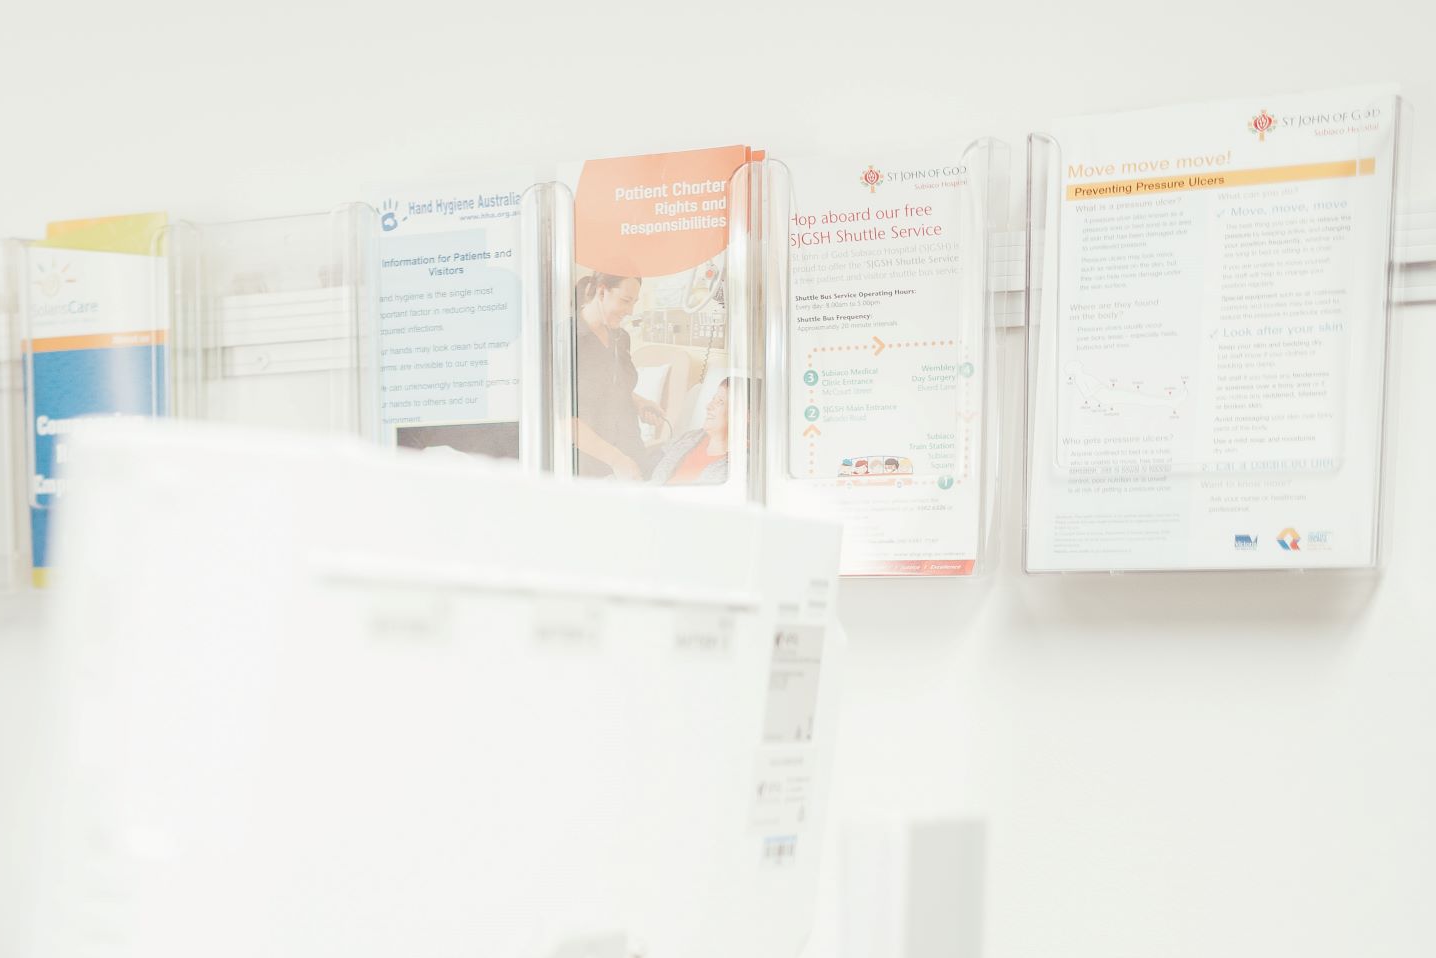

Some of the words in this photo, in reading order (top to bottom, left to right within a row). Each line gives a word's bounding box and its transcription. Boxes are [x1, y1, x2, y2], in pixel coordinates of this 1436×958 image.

[1282, 116, 1294, 127] ST
[1297, 114, 1330, 128] JOHN
[1332, 111, 1349, 122] OF
[1067, 163, 1116, 179] Move
[1121, 160, 1170, 174] move
[1176, 150, 1233, 169] move!
[886, 172, 898, 182] ST
[899, 169, 927, 182] JOHN
[927, 168, 942, 178] OF
[942, 165, 968, 178] GOD
[614, 184, 669, 202] Patient
[672, 178, 727, 197] Charter
[1073, 184, 1132, 198] Preventing
[1135, 179, 1185, 192] Pressure
[1188, 175, 1226, 187] Ulcers
[408, 200, 433, 216] Hand
[435, 197, 476, 216] Hygiene
[477, 191, 522, 209] Australia
[654, 200, 698, 217] Rights
[701, 195, 727, 210] and
[1313, 199, 1349, 211] move
[821, 207, 871, 224] aboard
[875, 207, 901, 221] our
[904, 202, 933, 218] free
[620, 215, 727, 236] Responsibilities
[790, 230, 832, 248] SJGSH
[836, 226, 886, 243] Shuttle
[891, 223, 942, 239] Service
[381, 254, 435, 269] Information
[437, 253, 452, 264] for
[453, 250, 491, 263] Patients
[494, 248, 513, 259] and
[895, 256, 926, 266] Shuttle
[927, 253, 960, 264] Service
[428, 265, 465, 277] Visitors
[379, 294, 393, 304] and
[434, 290, 447, 298] the
[473, 286, 494, 296] most
[795, 293, 819, 302] Shuttle
[820, 292, 832, 300] Bus
[833, 290, 857, 299] Service
[858, 288, 893, 299] Operating
[894, 287, 917, 296] Hours:
[797, 315, 821, 323] Shuttle
[822, 314, 835, 322] Bus
[836, 312, 873, 323] Frequency:
[1222, 326, 1253, 338] Look
[1256, 325, 1284, 337] after
[1286, 325, 1315, 338] your
[432, 343, 449, 353] look
[473, 341, 486, 350] but
[920, 362, 956, 373] Wembley
[806, 372, 815, 384] 3
[911, 373, 928, 384] Day
[929, 372, 956, 384] Surgery
[808, 408, 816, 419] 2
[928, 441, 956, 451] Station
